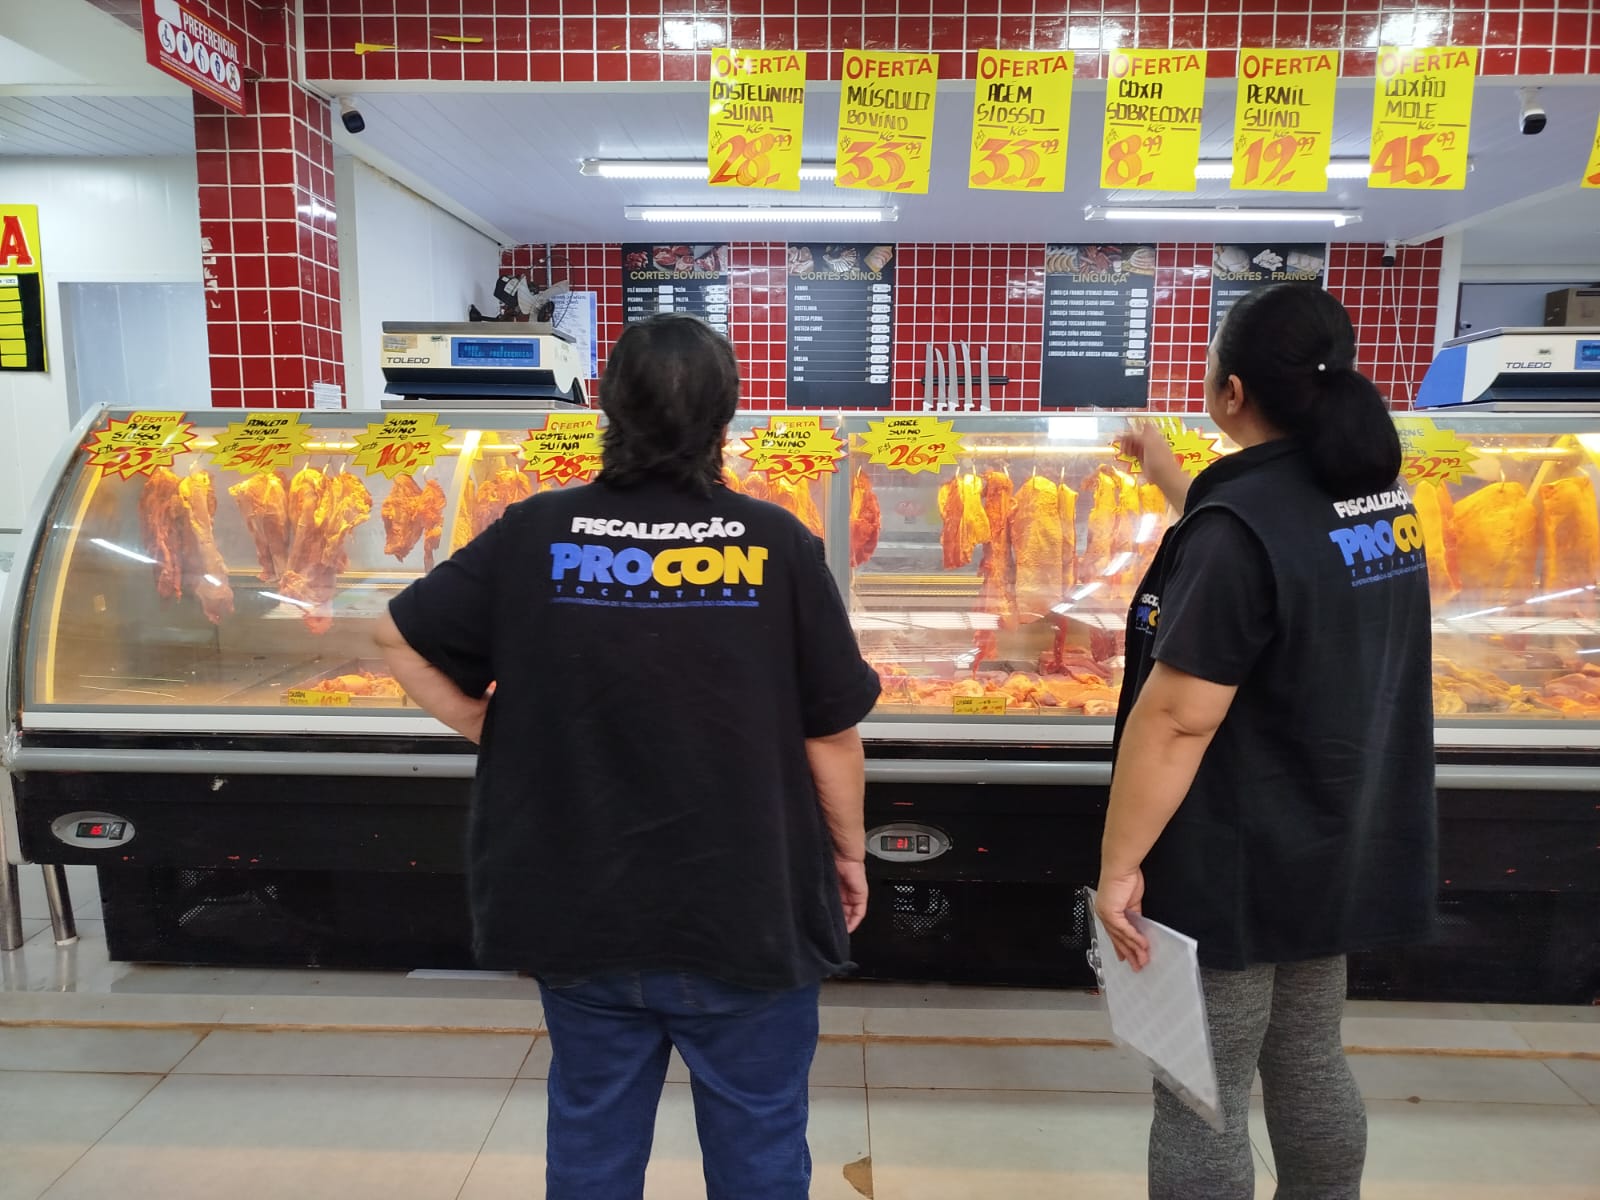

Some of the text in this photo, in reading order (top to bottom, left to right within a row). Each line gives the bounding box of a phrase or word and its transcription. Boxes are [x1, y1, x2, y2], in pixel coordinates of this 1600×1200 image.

[182, 11, 240, 64] PREFERENCIAL
[715, 55, 800, 77] OFERTA
[846, 56, 932, 79] OFERTA
[981, 56, 1068, 79] OFERTA
[1112, 55, 1200, 78] OFERTA
[1243, 55, 1332, 78] OFERTA
[1382, 50, 1470, 76] OFERTA
[847, 82, 931, 110] MÚSCULO
[1119, 79, 1163, 99] COXA
[1247, 84, 1311, 106] PERNIL
[1385, 100, 1437, 119] MOLE
[746, 124, 764, 133] KG
[1009, 126, 1028, 136] KG
[1418, 121, 1436, 130] KG
[879, 132, 895, 141] KG
[630, 271, 720, 280] CORTES BOVINOS
[800, 271, 840, 280] CORTES
[1219, 272, 1262, 281] CORTES
[1271, 272, 1317, 281] FRANGO
[387, 356, 430, 364] TOLEDO
[132, 415, 177, 423] OFERTA
[551, 420, 593, 430] OFERTA
[774, 421, 816, 429] OFERTA
[571, 517, 746, 542] FISCALIZAÇÃO
[1328, 513, 1423, 567] PROCO
[550, 543, 769, 587] PROCON
